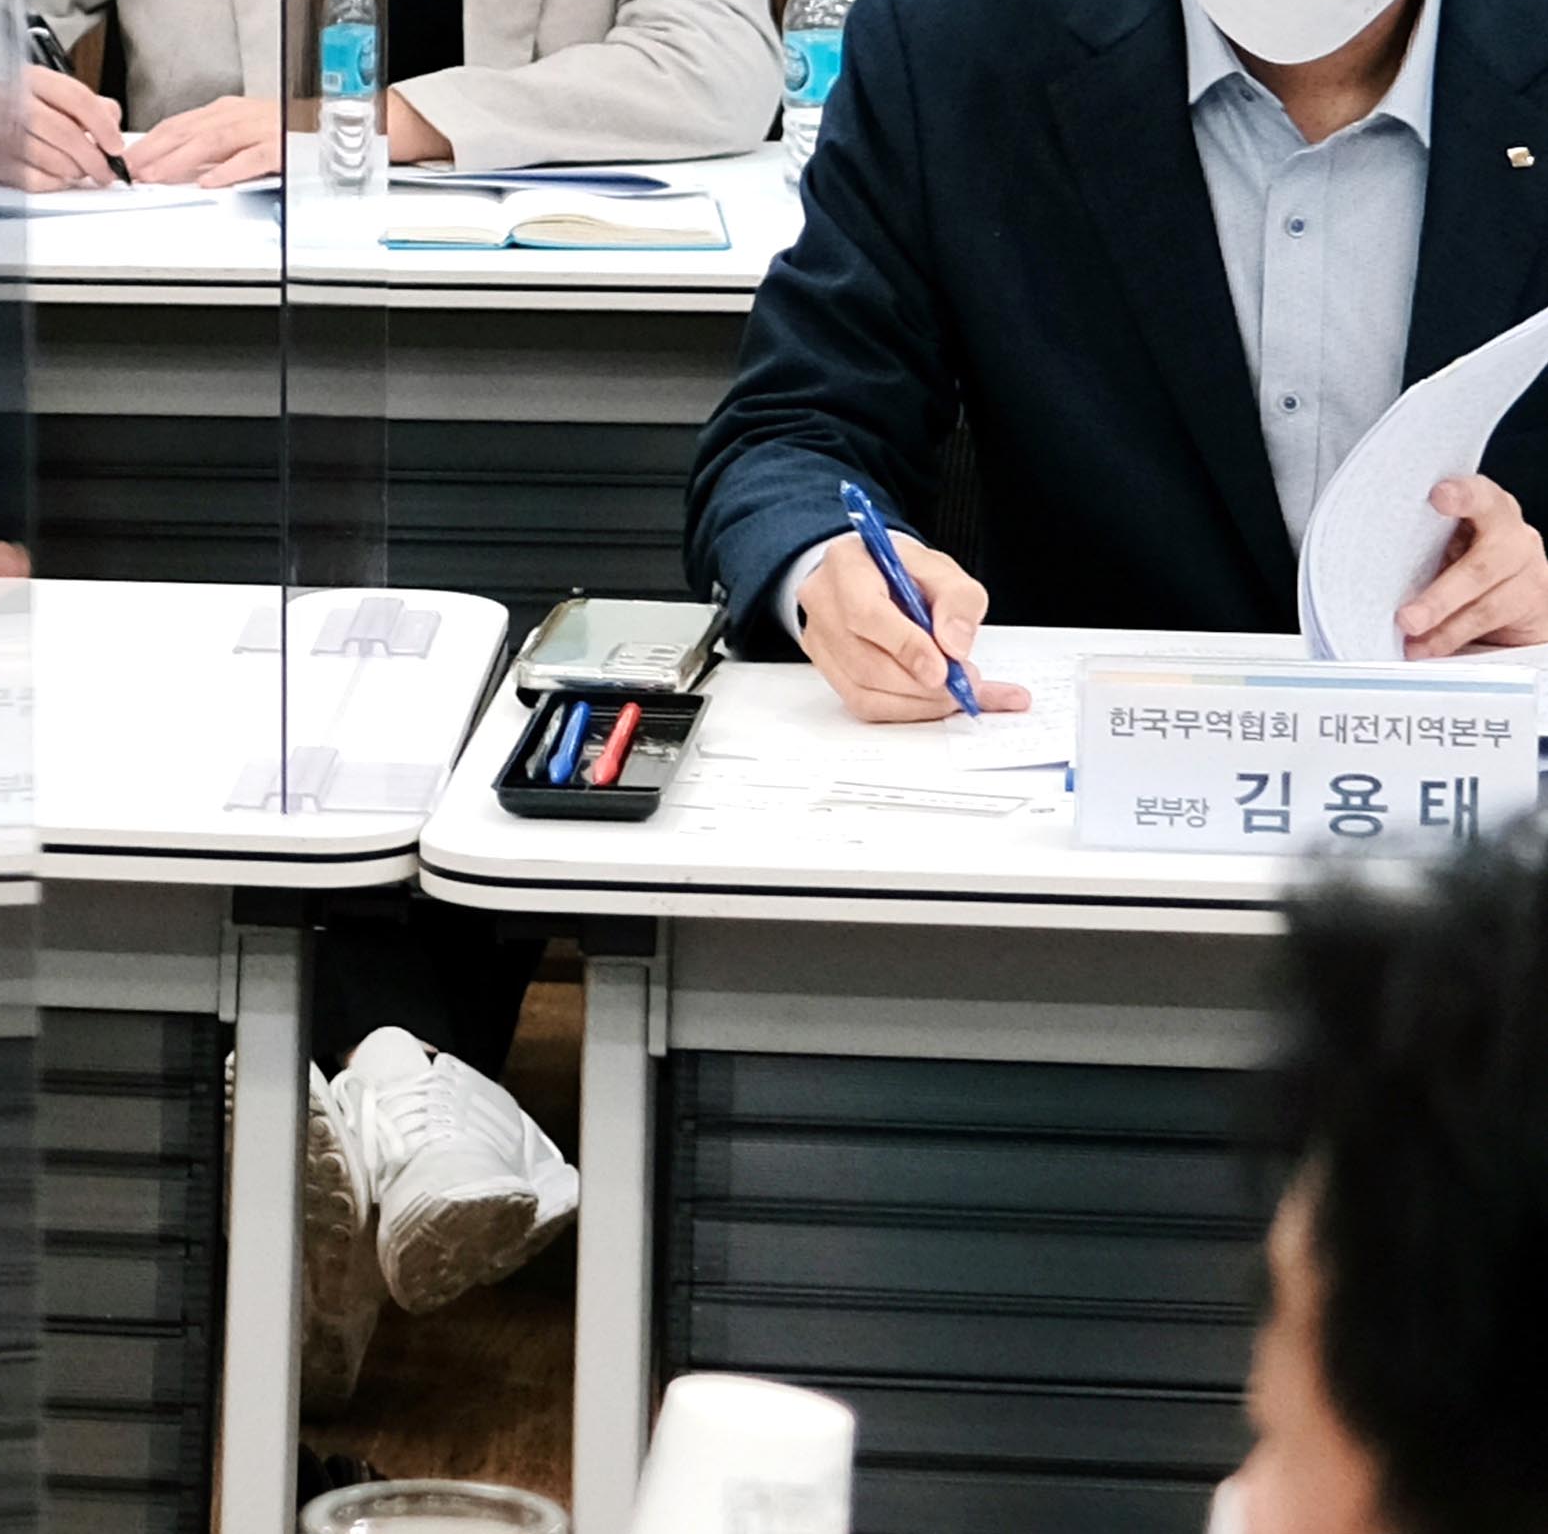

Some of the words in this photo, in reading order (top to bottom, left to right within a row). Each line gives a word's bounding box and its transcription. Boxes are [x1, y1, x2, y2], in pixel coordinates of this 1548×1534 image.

[1107, 705, 1301, 744] 한국무역협회
[1317, 712, 1514, 750] 대전지역본부
[1132, 794, 1211, 829] 본부장
